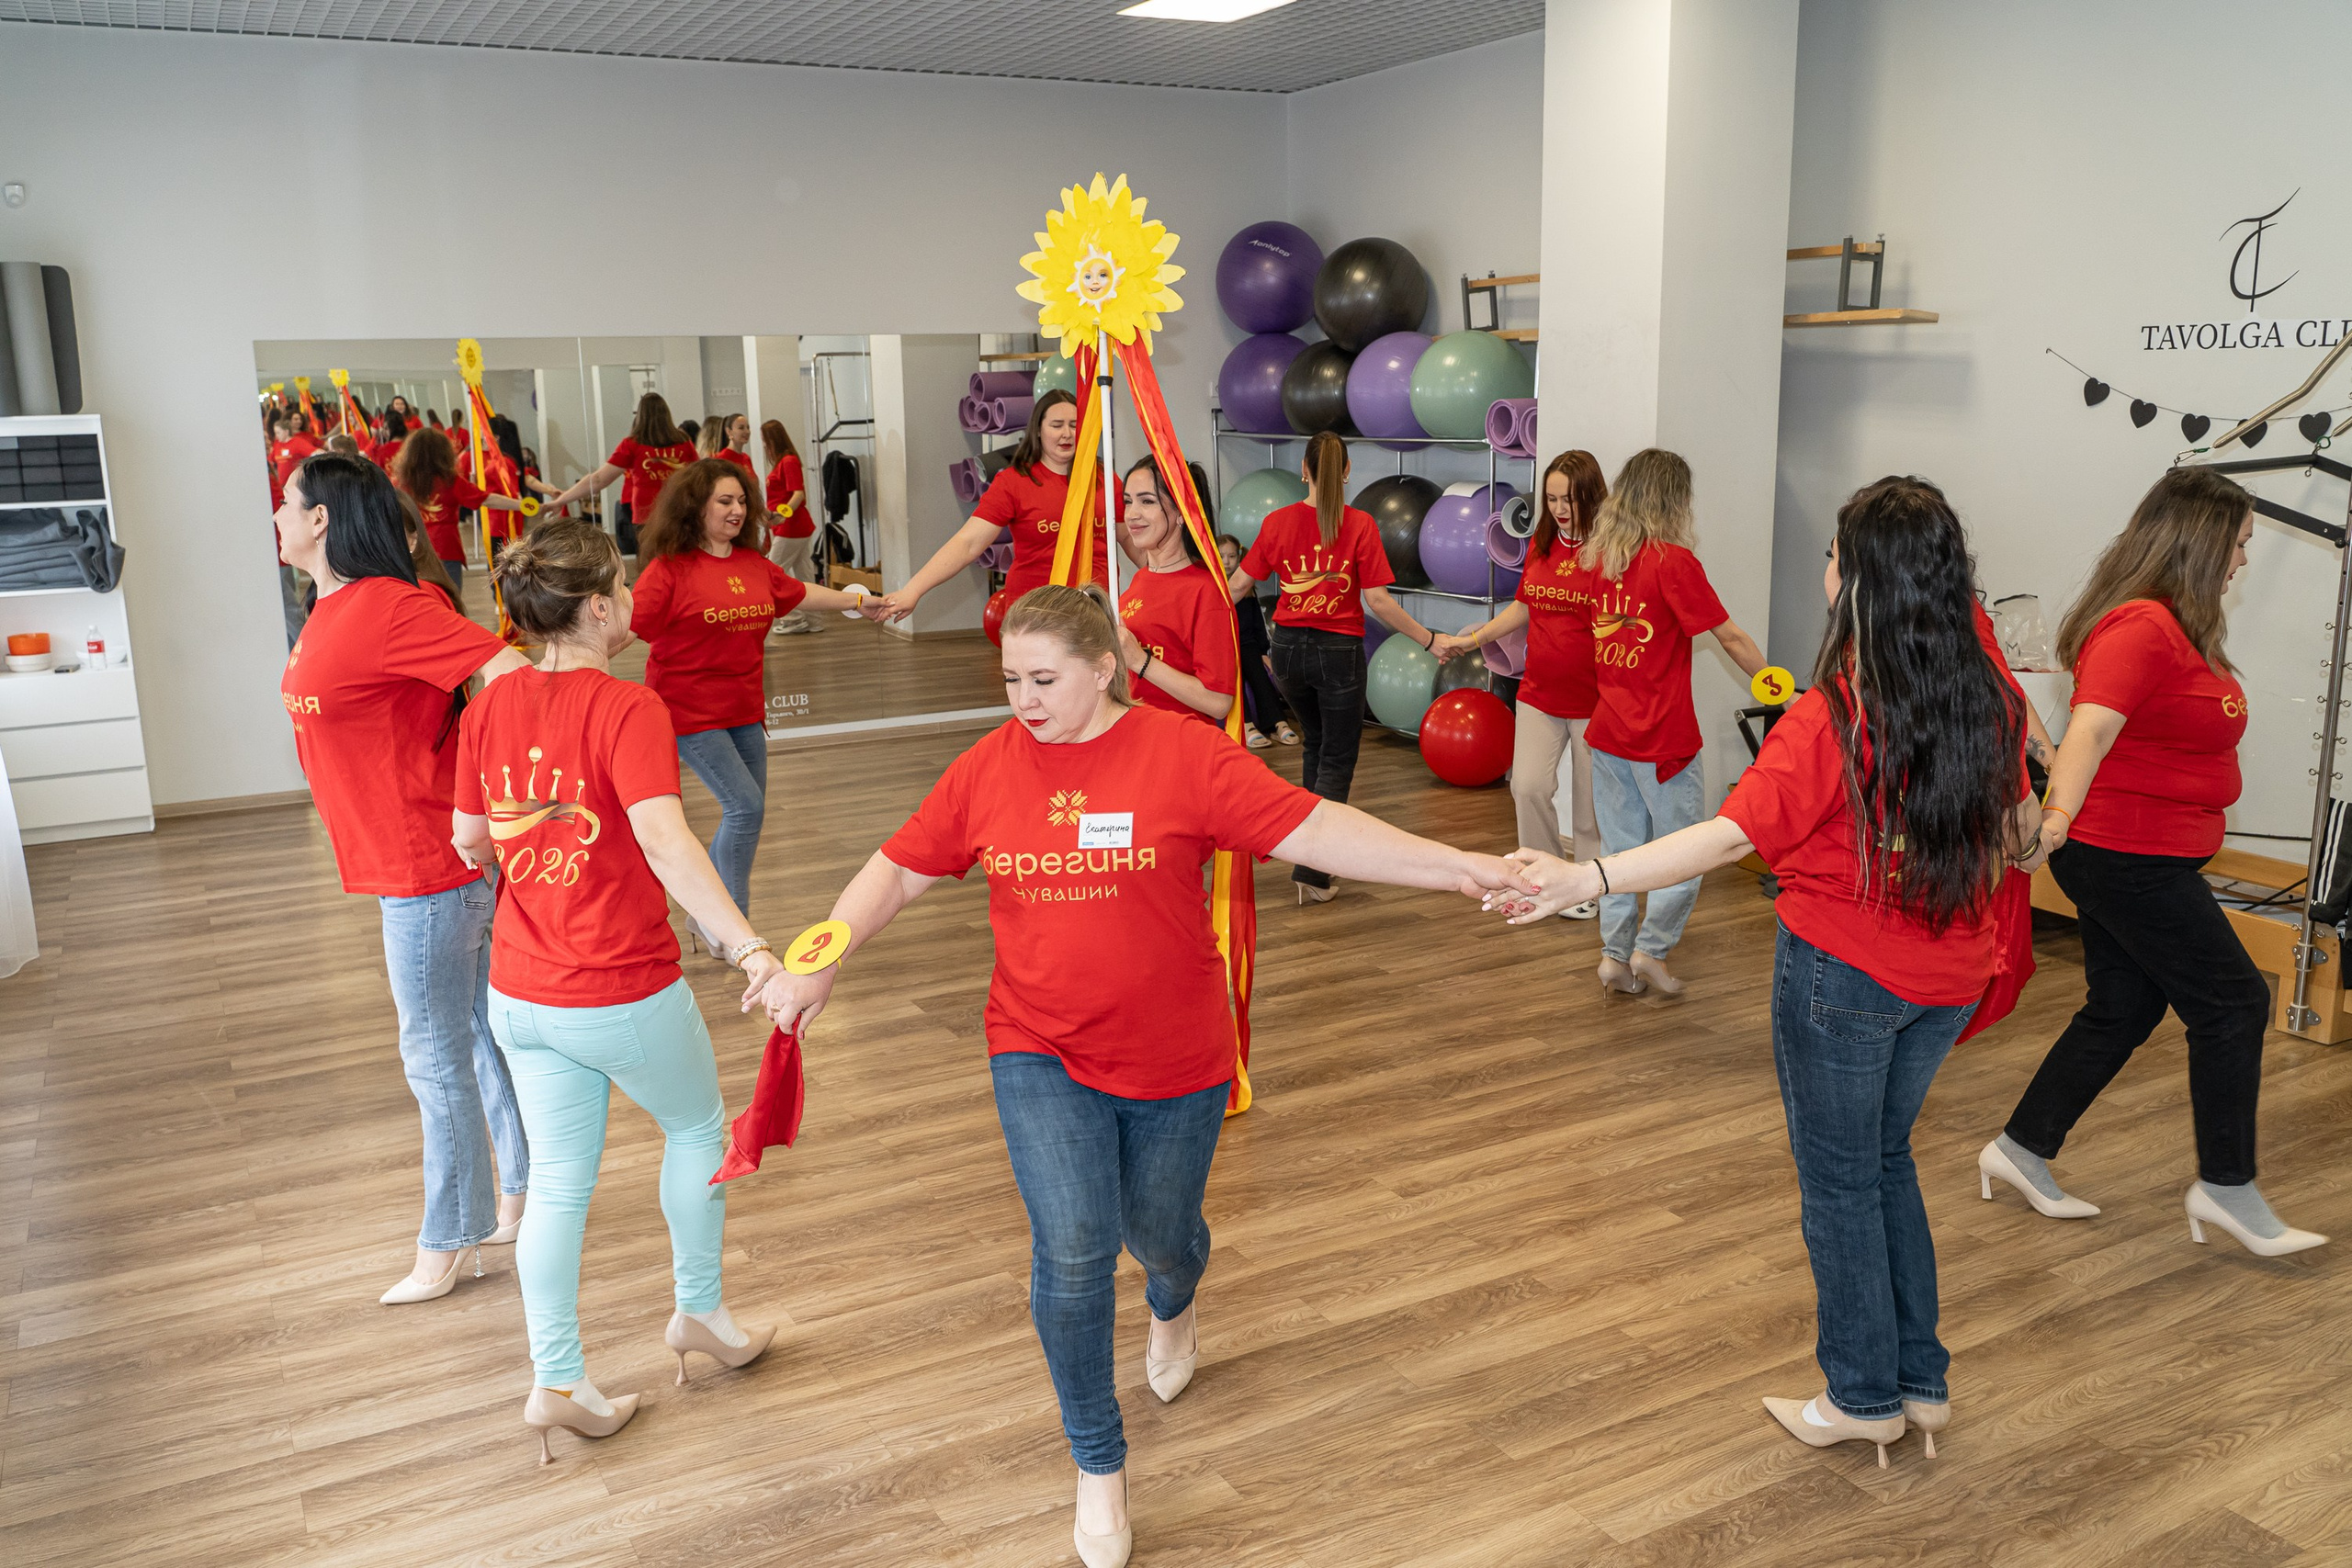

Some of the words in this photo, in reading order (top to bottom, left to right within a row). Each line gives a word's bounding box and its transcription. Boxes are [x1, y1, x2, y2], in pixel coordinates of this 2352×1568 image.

[2141, 321, 2285, 350] TAVOLGA
[704, 604, 775, 624] берегин
[1594, 640, 1645, 669] 2026
[772, 694, 808, 708] CLUB
[983, 846, 1156, 882] берегиня
[1012, 884, 1118, 904] чувашии
[797, 931, 832, 964] 2
